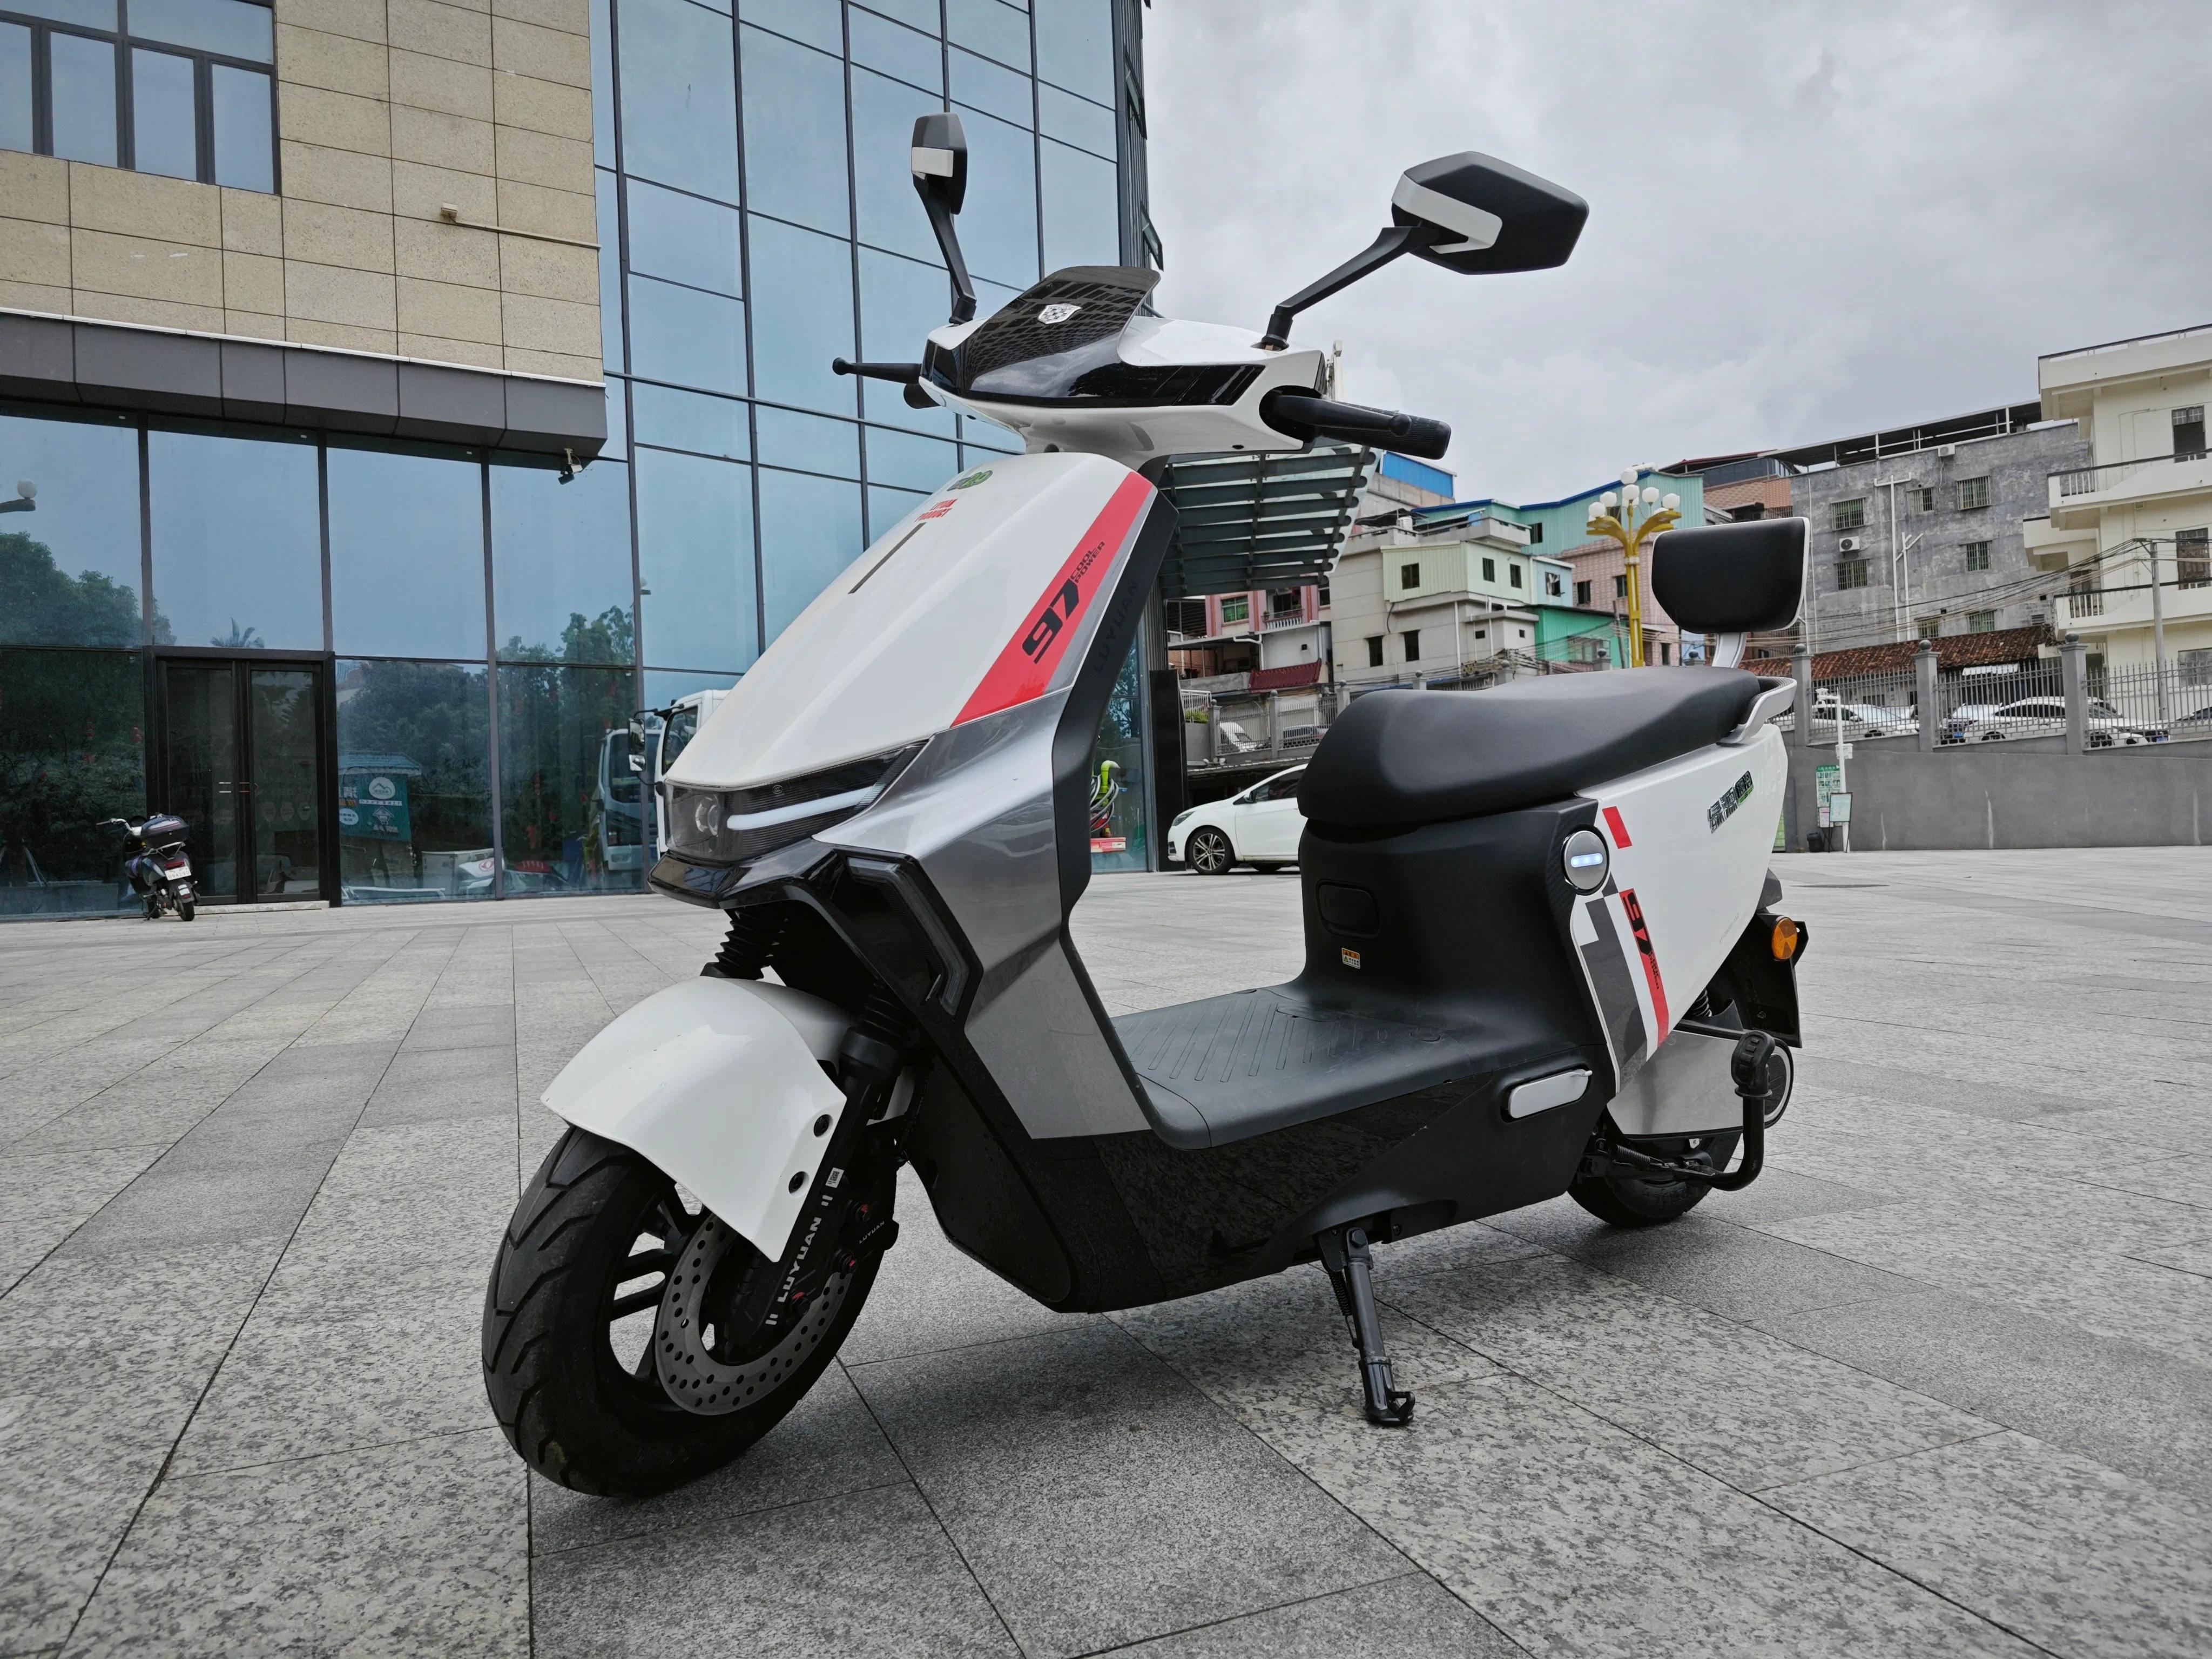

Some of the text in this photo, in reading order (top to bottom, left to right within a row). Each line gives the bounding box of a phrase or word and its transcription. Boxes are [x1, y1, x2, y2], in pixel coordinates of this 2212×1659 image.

[1070, 547, 1096, 580] COOL
[1074, 541, 1105, 584] POWER
[1022, 578, 1080, 665] 97
[1622, 892, 1653, 955] 97
[859, 1220, 885, 1244] LUYUAN
[777, 1216, 822, 1303] LUYUAN
